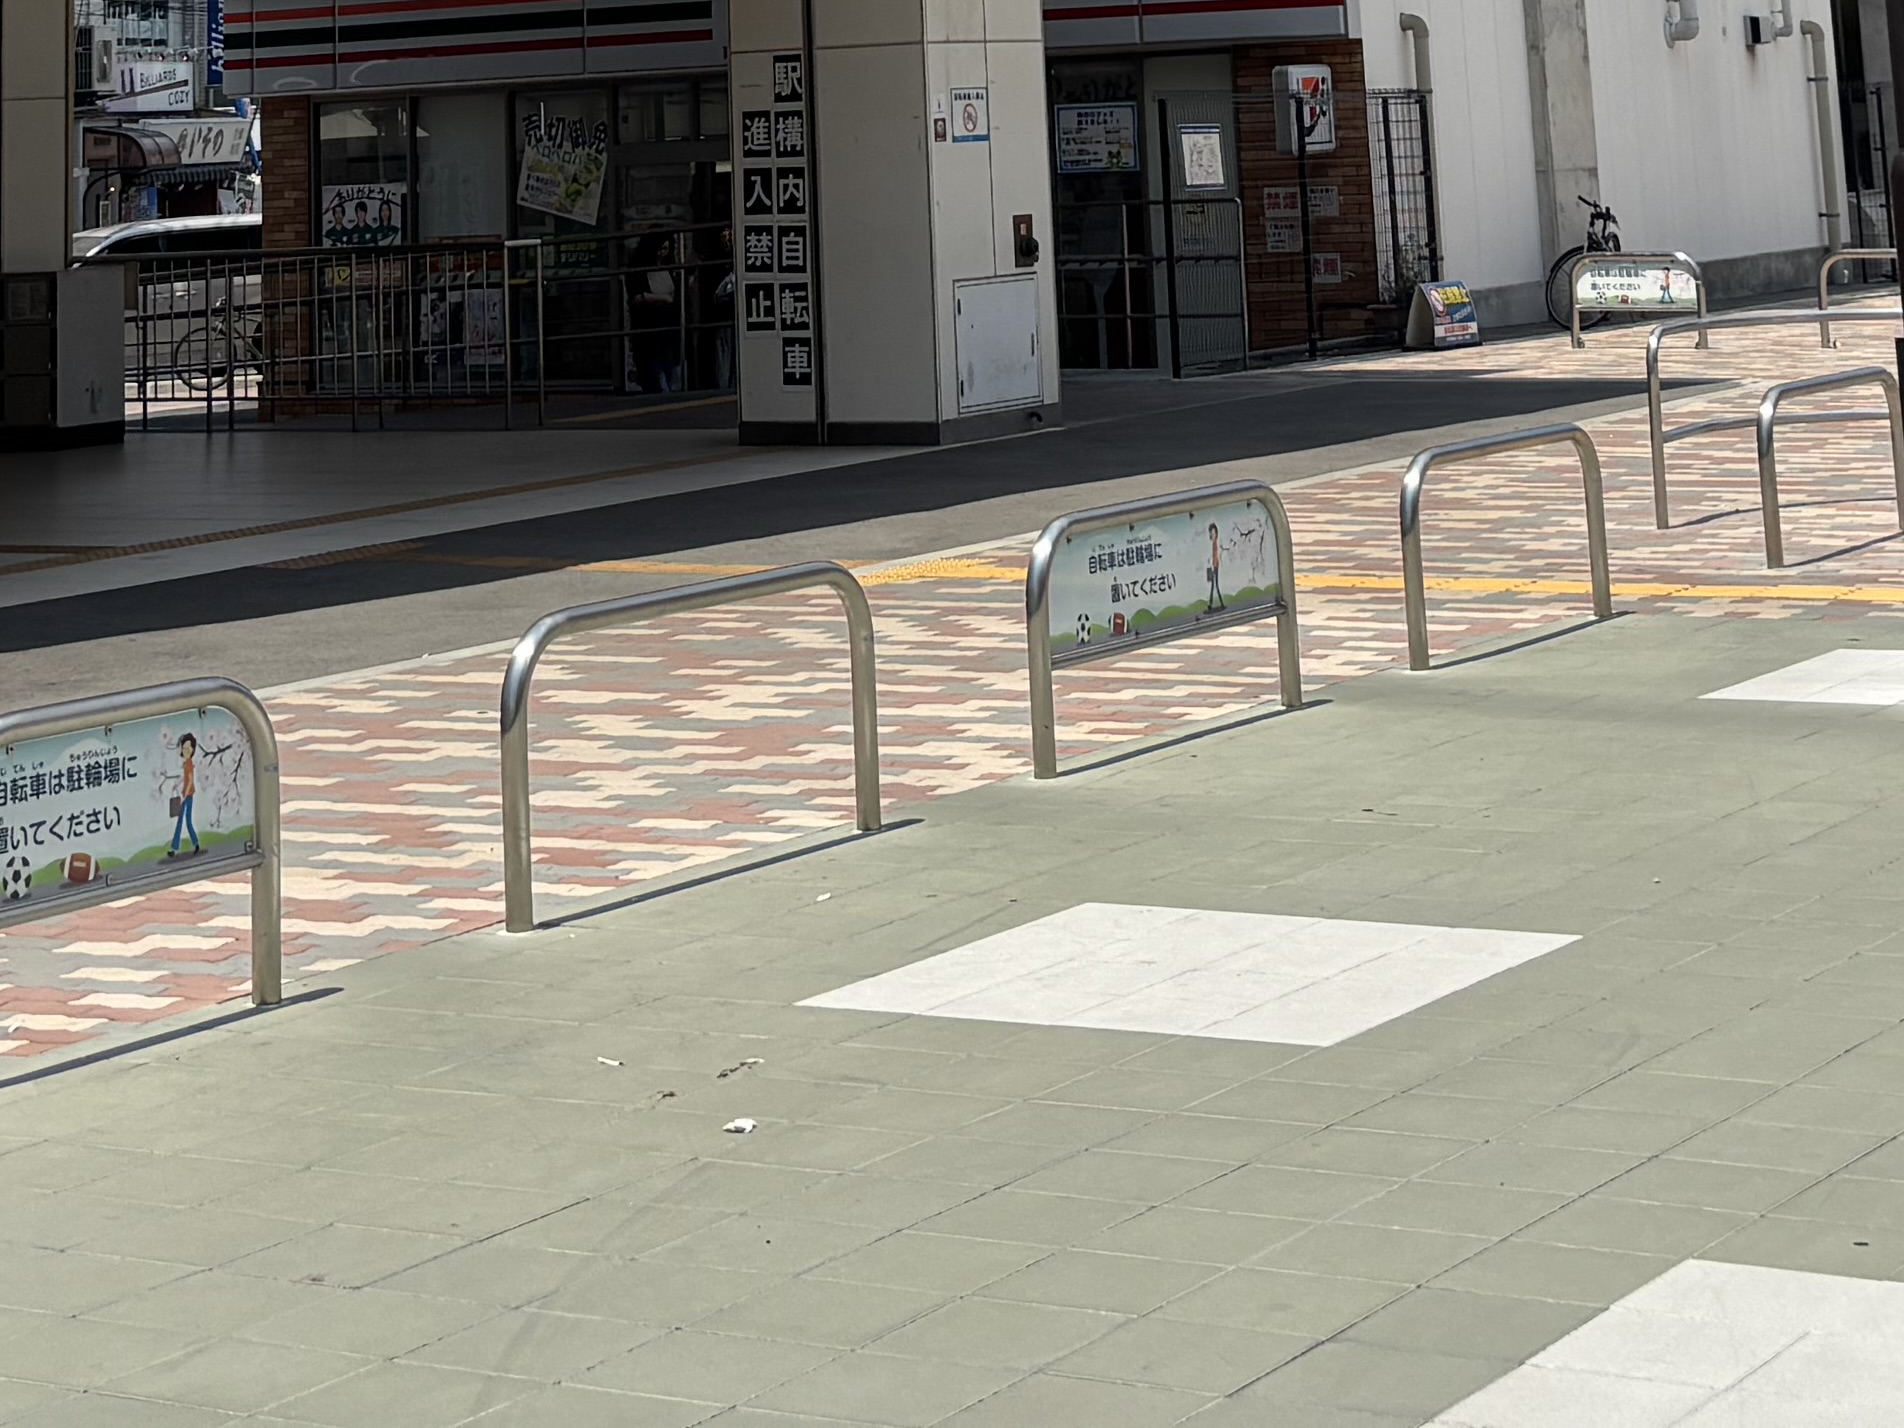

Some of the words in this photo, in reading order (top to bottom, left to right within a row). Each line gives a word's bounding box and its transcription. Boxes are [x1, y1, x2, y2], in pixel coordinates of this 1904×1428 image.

[140, 68, 177, 89] BILLIARDS
[167, 90, 190, 106] COZY
[743, 116, 775, 324] 進入禁止
[774, 60, 812, 380] 駅構内自転車
[1111, 573, 1176, 603] 置いてください
